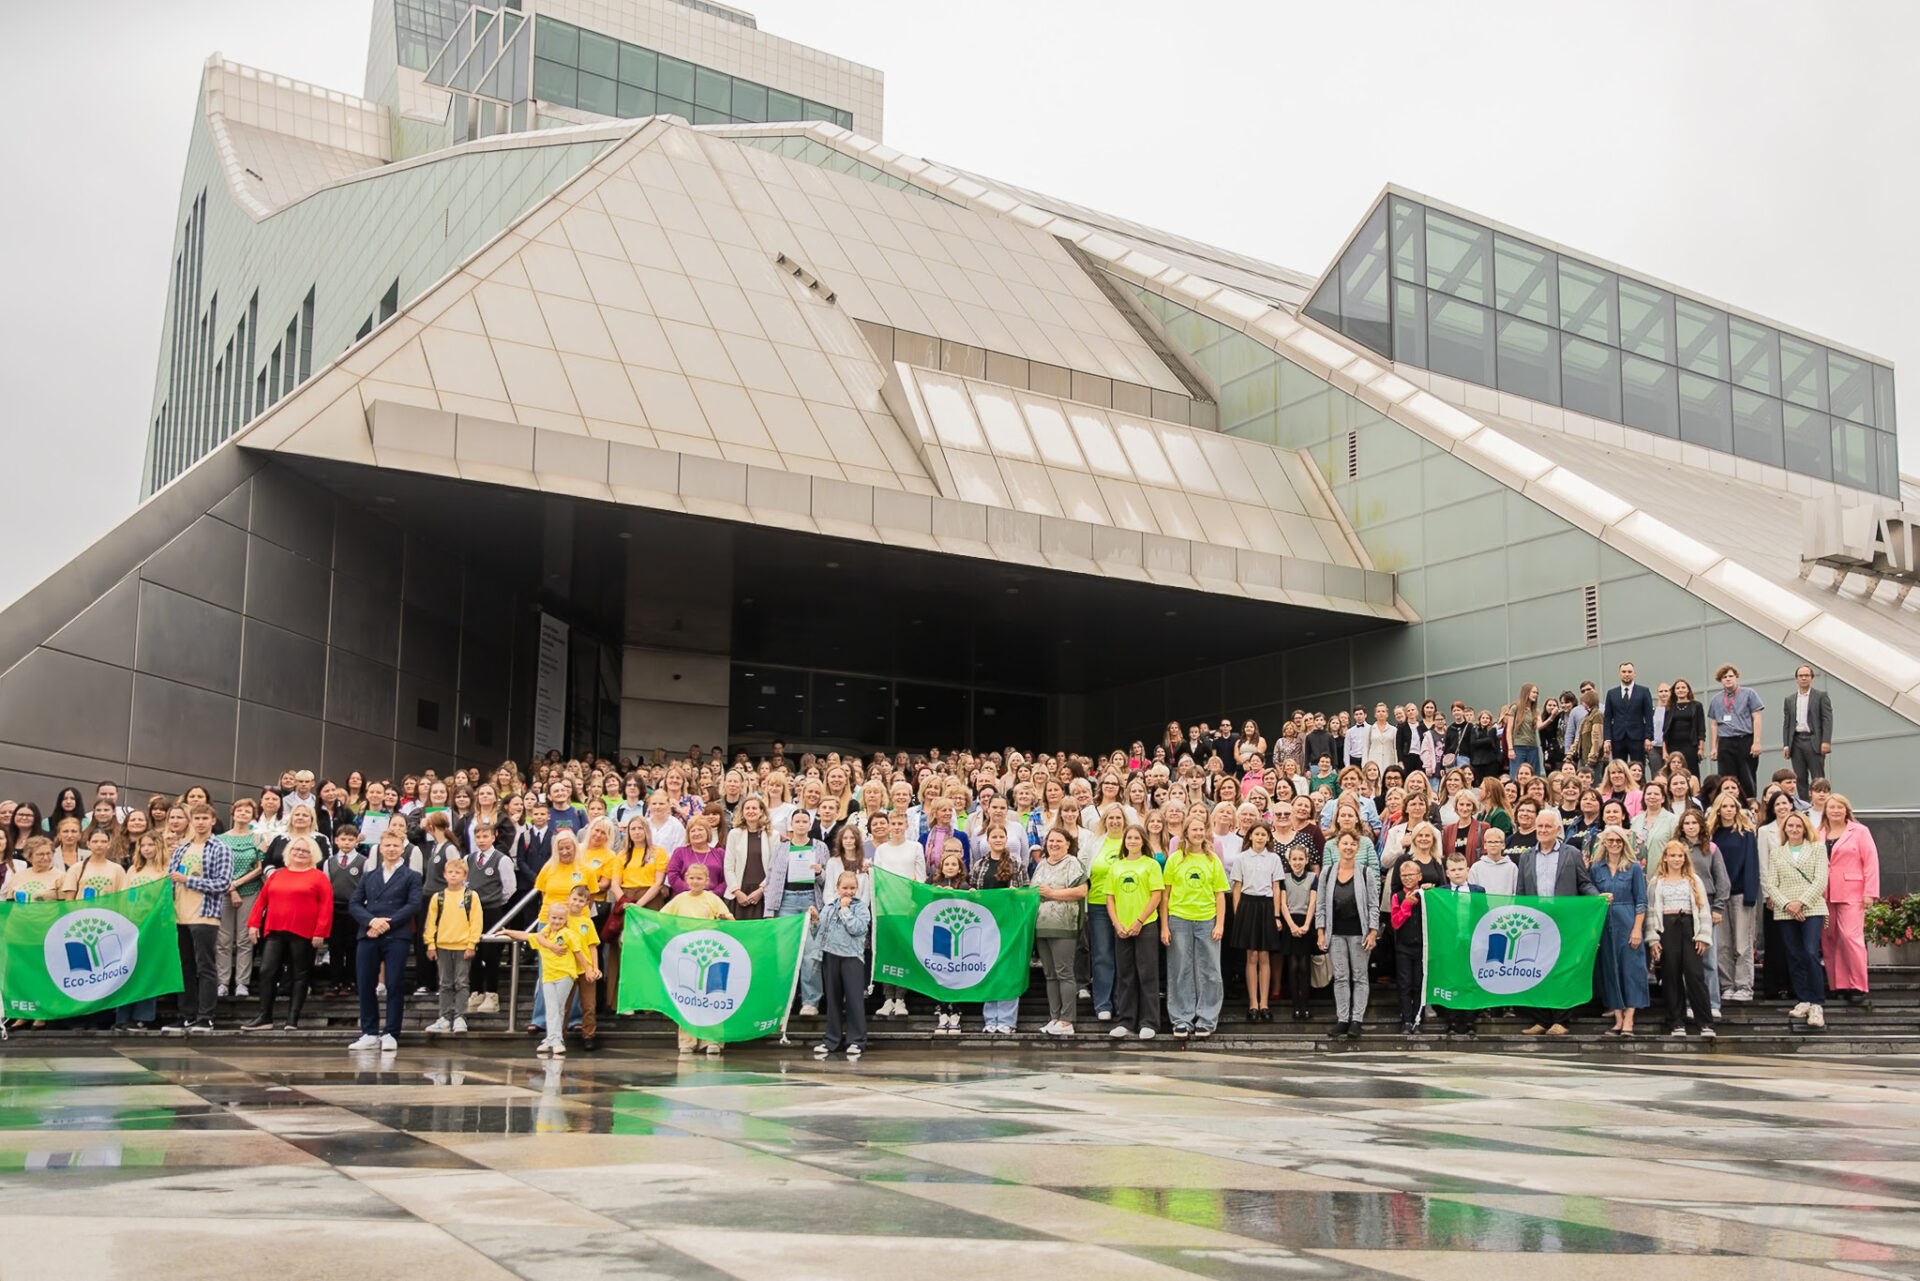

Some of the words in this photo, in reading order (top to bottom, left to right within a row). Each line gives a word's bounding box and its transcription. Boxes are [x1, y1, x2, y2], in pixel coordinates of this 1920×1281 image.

[924, 958, 987, 973] Eco-Schools
[1478, 965, 1542, 979] Eco-Schools
[63, 965, 129, 989] Eco-Schools
